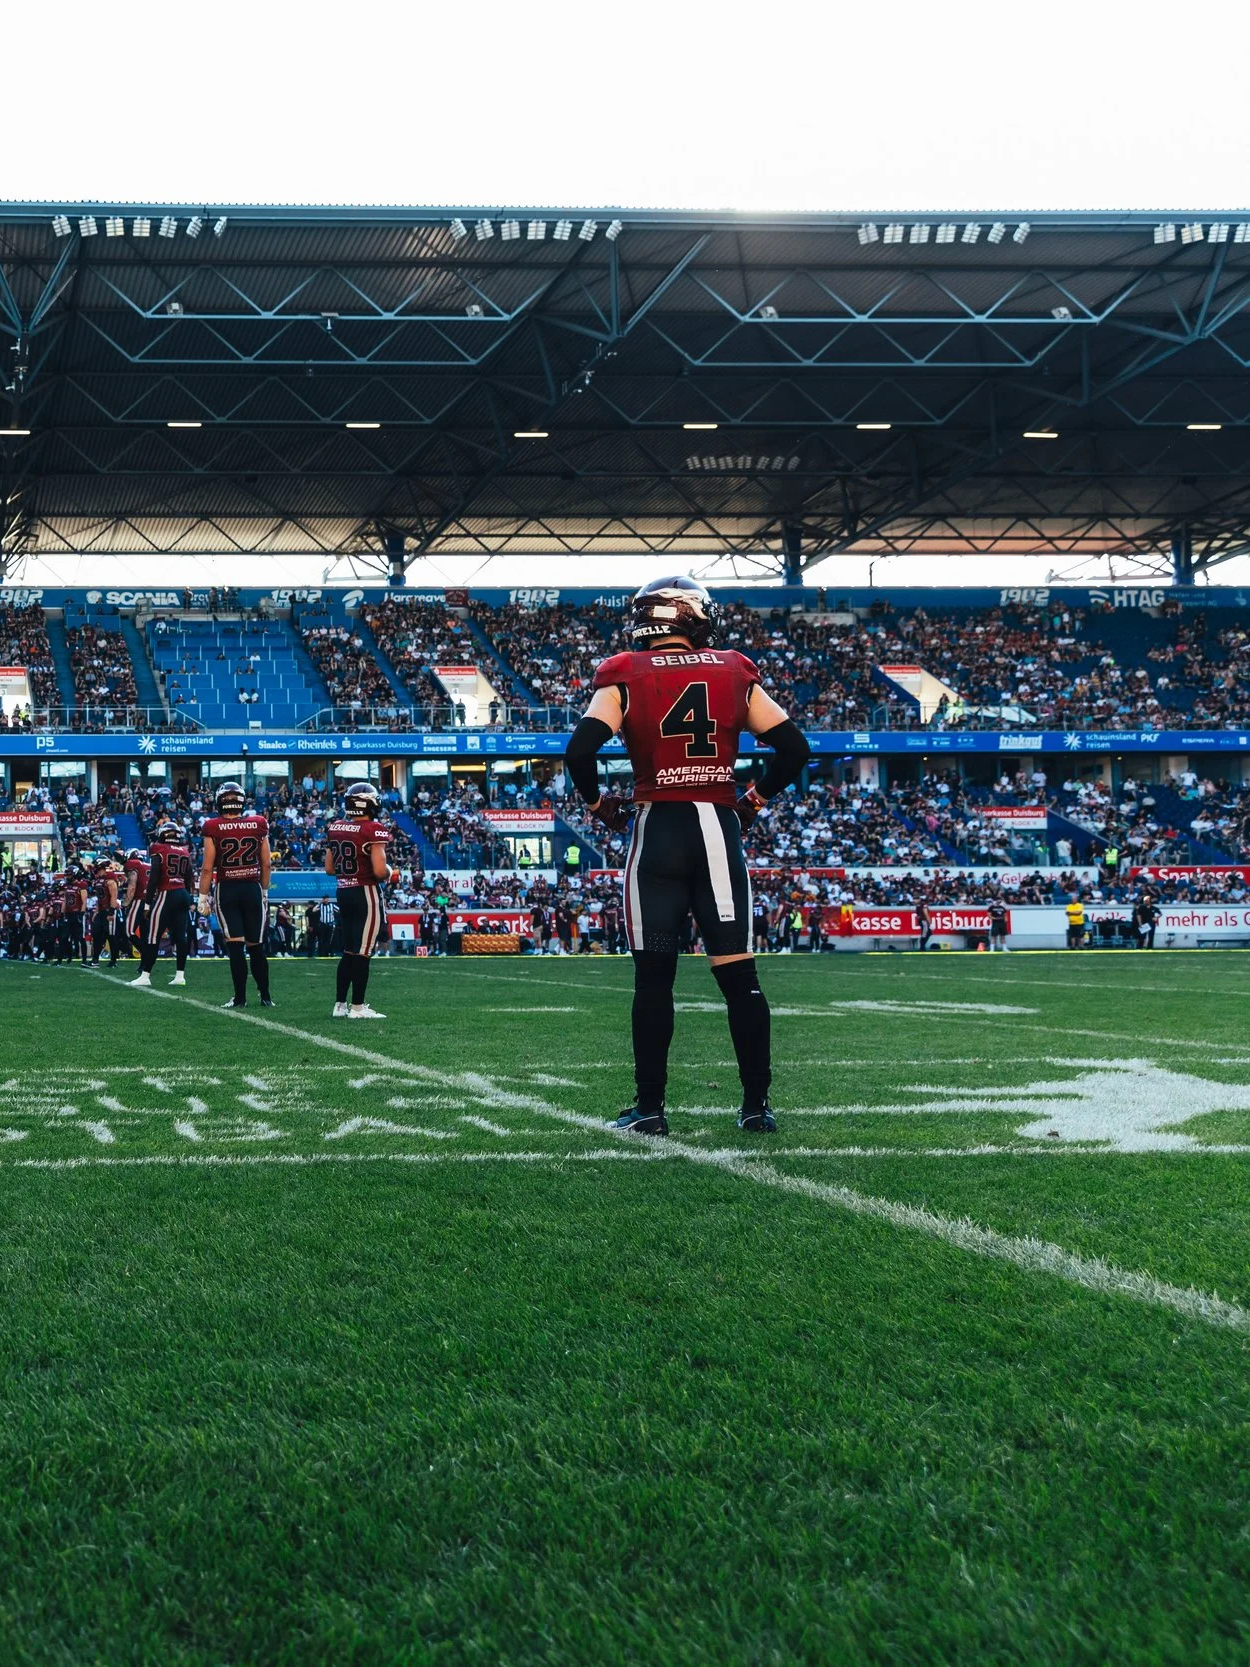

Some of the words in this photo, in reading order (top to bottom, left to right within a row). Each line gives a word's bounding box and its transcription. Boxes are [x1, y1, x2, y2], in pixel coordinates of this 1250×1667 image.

[106, 591, 180, 606] SCANIA
[384, 592, 447, 604] Hargreave
[1000, 590, 1050, 602] 1902
[1113, 590, 1165, 608] HTAG
[651, 653, 725, 666] SEIBEL
[660, 682, 718, 758] 4
[1086, 733, 1137, 741] schauinsland
[1140, 733, 1160, 743] PKF
[258, 740, 287, 749] Sinalco
[298, 739, 337, 750] Rheinfels
[353, 741, 386, 750] Sparkasse
[387, 741, 418, 750] Duisburg
[656, 766, 734, 777] AMERICAN
[656, 774, 736, 785] TOURISTER
[19, 814, 51, 823] Duisburg
[484, 812, 518, 821] Sparkasse
[520, 812, 552, 821] Duisburg
[1013, 809, 1044, 817] Duisburg
[218, 822, 258, 831] WOYWOD
[220, 837, 259, 868] 22
[330, 840, 359, 876] 28
[166, 853, 191, 878] 50
[852, 913, 901, 930] kasse
[1166, 910, 1209, 927] mehr
[1214, 911, 1238, 927] als
